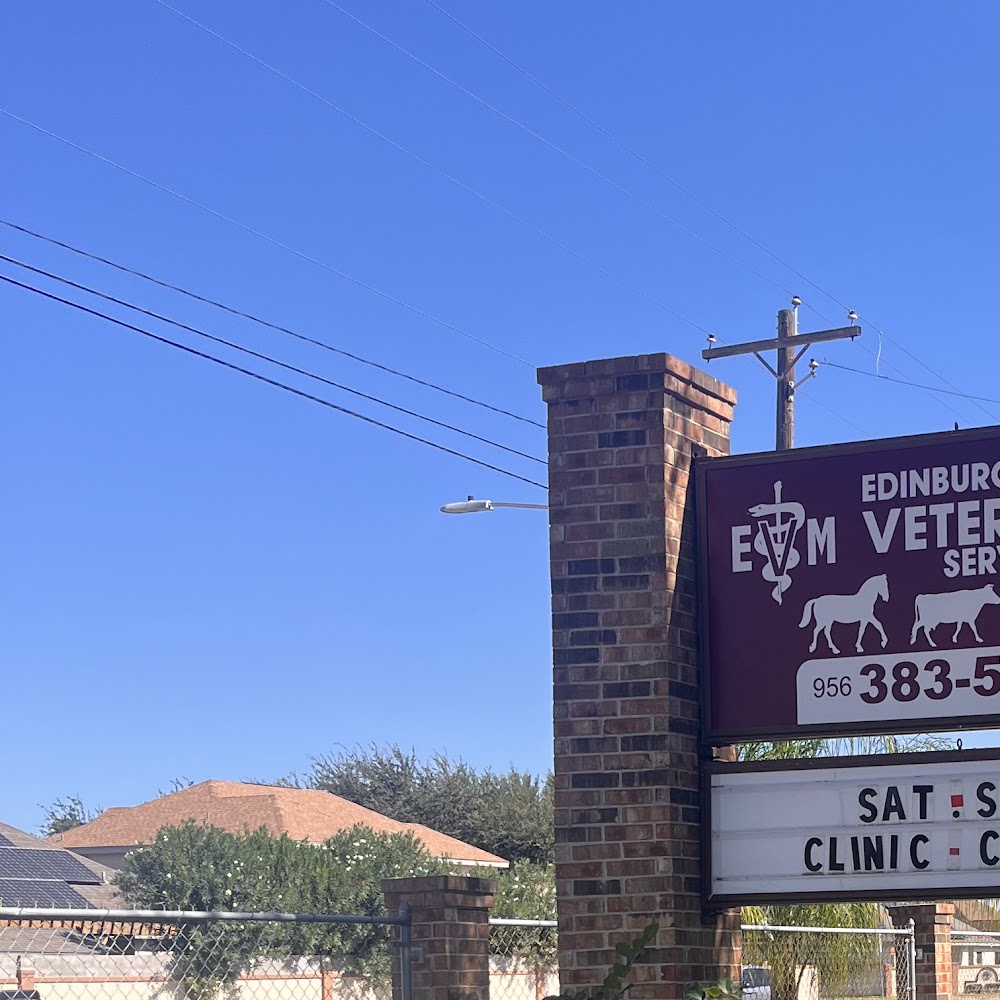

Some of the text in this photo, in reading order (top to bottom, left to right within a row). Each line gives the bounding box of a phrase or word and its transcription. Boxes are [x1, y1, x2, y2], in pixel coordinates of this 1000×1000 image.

[812, 675, 852, 699] 956
[858, 784, 934, 824] SAT
[804, 833, 931, 873] CLINIC
